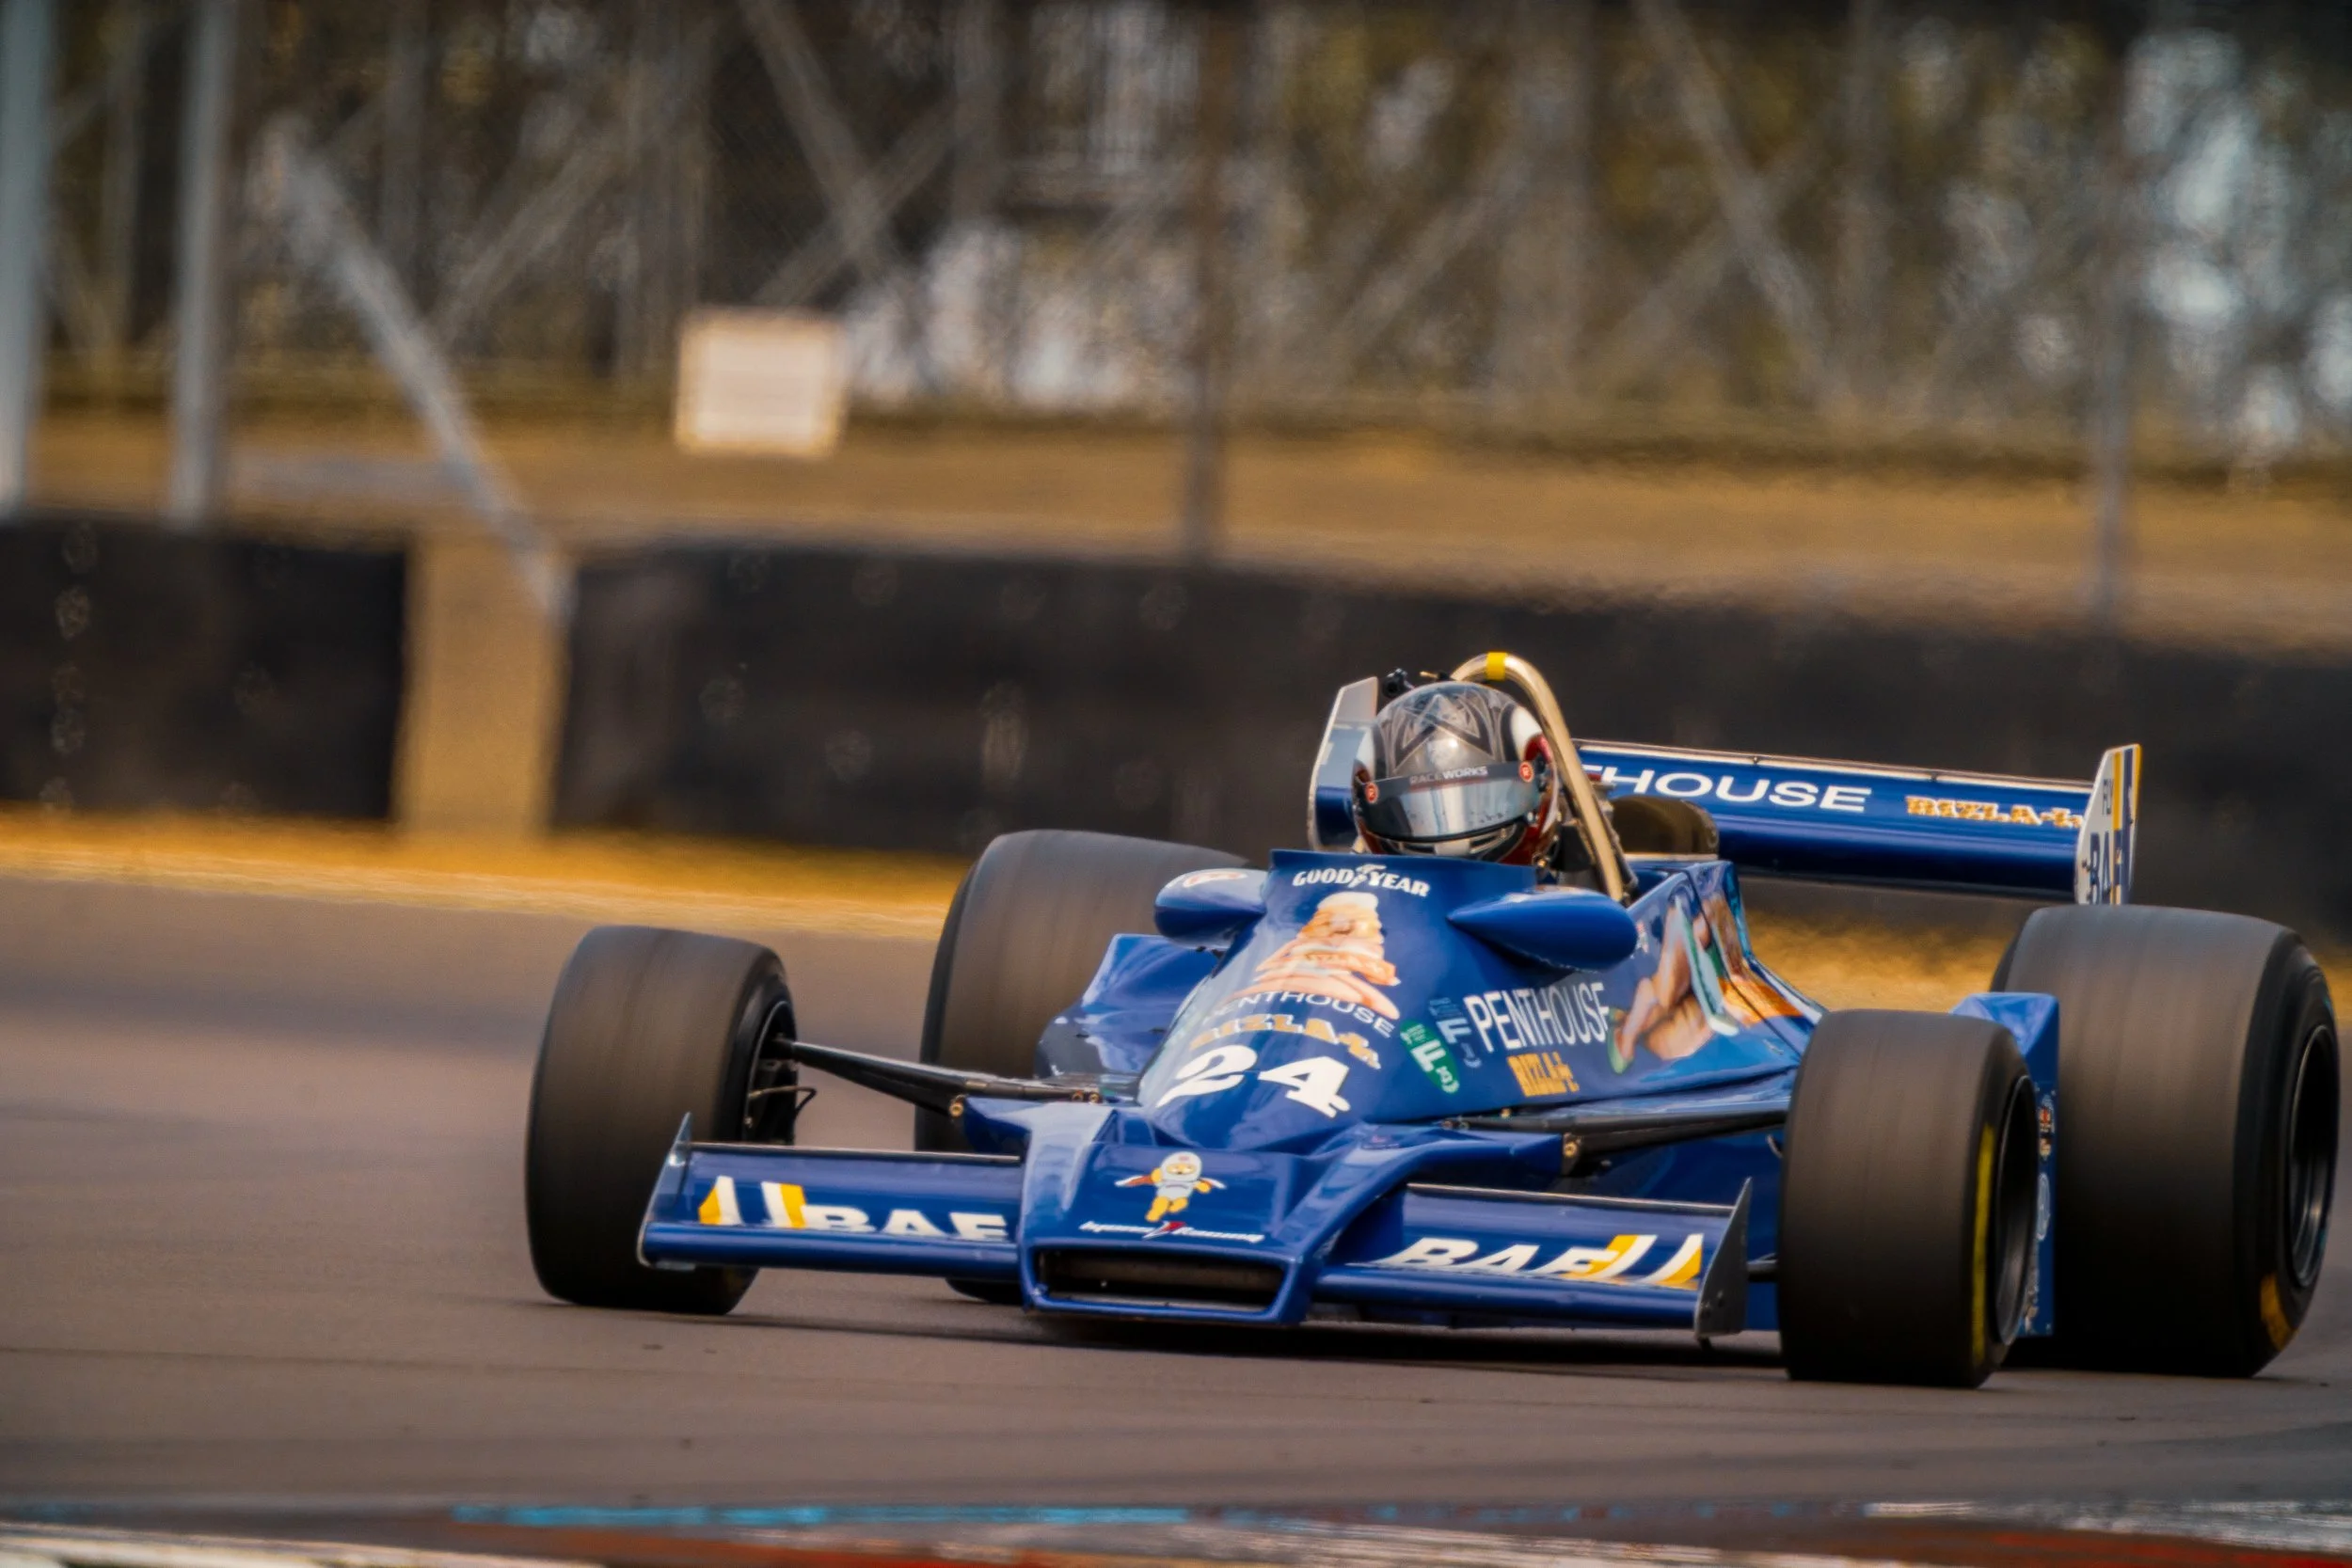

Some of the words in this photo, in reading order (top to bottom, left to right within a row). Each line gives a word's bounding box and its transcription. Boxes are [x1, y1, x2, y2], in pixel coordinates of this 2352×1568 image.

[1292, 866, 1431, 897] GOODYEAR
[1463, 981, 1610, 1053] PENTHOUSE
[1155, 1044, 1351, 1117] 24
